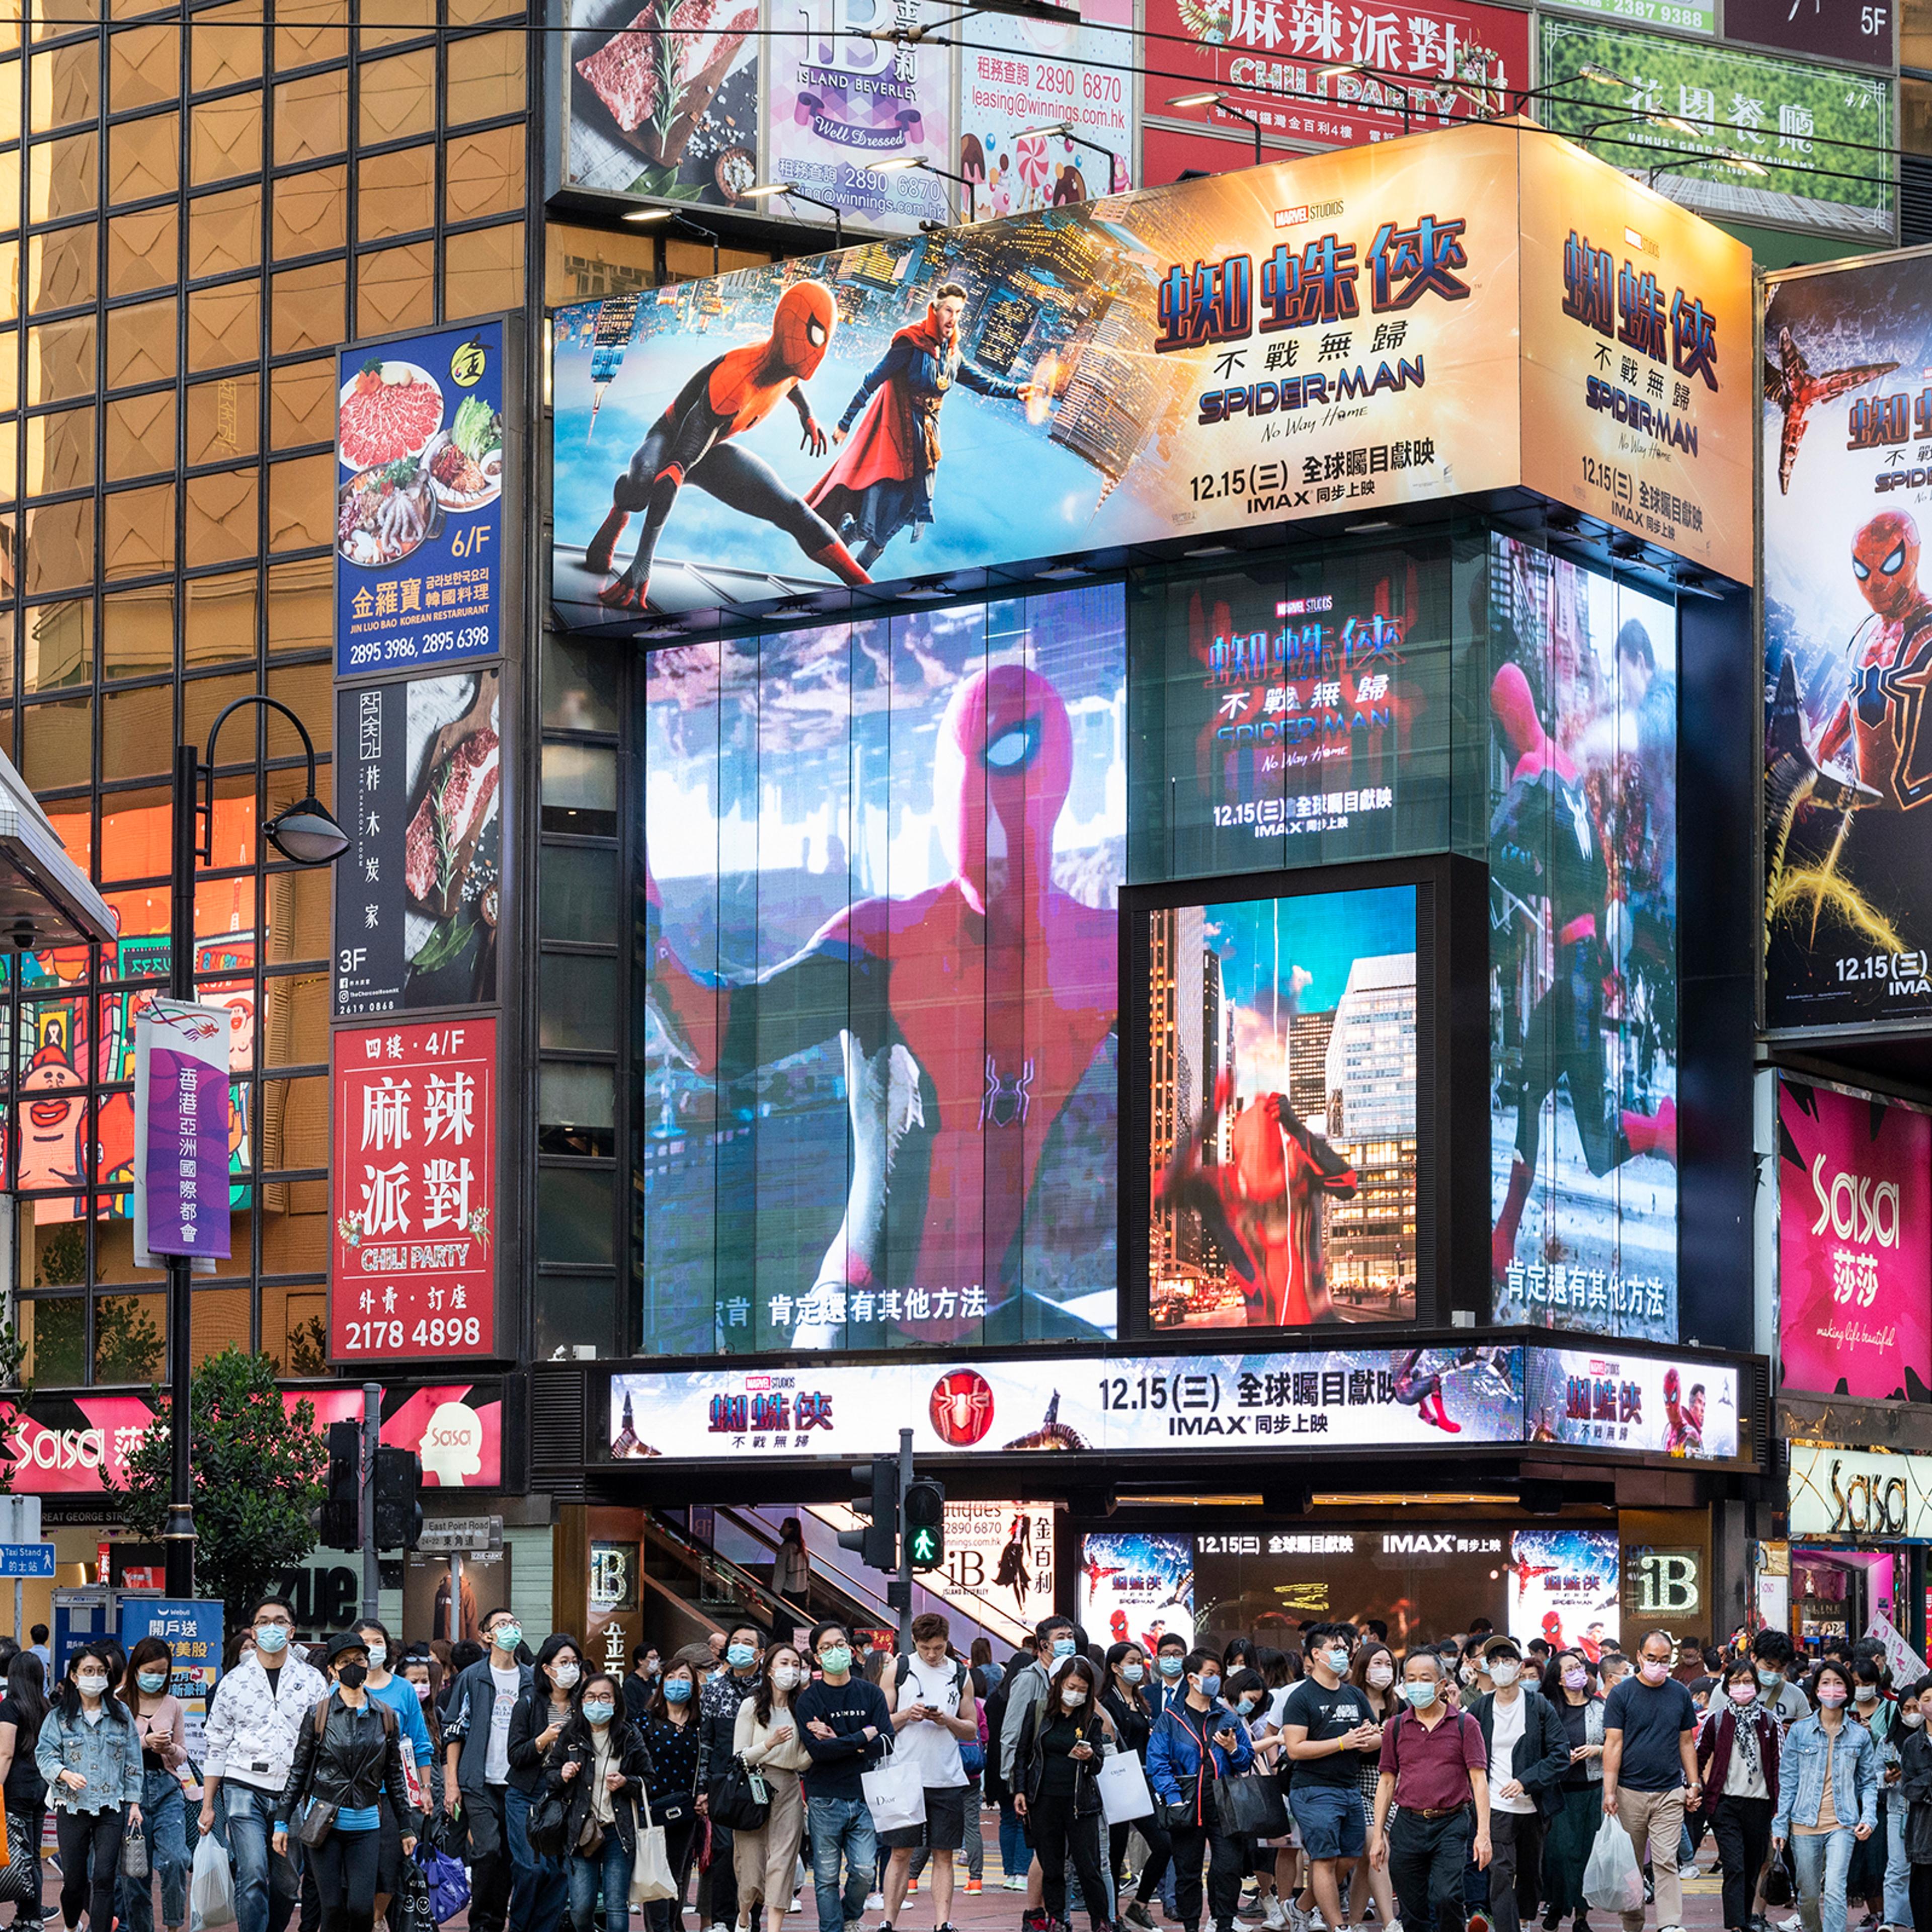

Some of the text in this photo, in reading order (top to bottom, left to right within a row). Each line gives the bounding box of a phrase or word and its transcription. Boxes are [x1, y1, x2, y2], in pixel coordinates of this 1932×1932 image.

[1614, 0, 1704, 28] 2387 9388
[1861, 6, 1887, 36] 5F
[1227, 0, 1462, 80] 麻辣派對
[797, 70, 920, 101] ISLAND BEVERLEY
[977, 55, 1121, 103] 租務查詢 2890 6870
[972, 86, 1125, 129] leasing@winnings.com.hk
[1337, 74, 1458, 124] PARTY
[1844, 92, 1872, 110] 4/F
[815, 115, 906, 147] Well Dressed
[778, 157, 941, 201] 租務查詢 2890 6870
[1276, 201, 1344, 227] MARVEL STUDIOS
[1155, 213, 1471, 354] 蜘蛛俠
[1562, 228, 1719, 392] 蜘蛛俠
[1213, 319, 1408, 380] 不戰無歸
[1593, 342, 1691, 413] 不戰無歸
[1261, 423, 1281, 443] No
[1284, 419, 1316, 440] Way
[1618, 432, 1629, 450] No
[1630, 437, 1647, 459] Way
[1190, 438, 1435, 502] 12.15(三) 全球矚目獻映
[1581, 455, 1633, 504] 12.15(三)
[1247, 479, 1376, 514] IMAX 同步上映
[1612, 501, 1675, 542] IMAX 同步上映
[451, 525, 491, 557] 6/F
[352, 577, 422, 619] 金羅寶
[425, 582, 490, 608] 韓國料理
[350, 624, 362, 634] JIN
[362, 620, 380, 631] LUO
[380, 617, 397, 629] BAO
[400, 612, 432, 626] KOREAN
[350, 624, 489, 665] 2895 3986, 2895 6398
[1204, 613, 1406, 688] 蜘蛛俠
[1220, 674, 1390, 719] 不戰無歸
[1261, 755, 1278, 772] No
[1213, 798, 1285, 828] 12.15(三)
[1255, 820, 1302, 837] IMAX
[364, 764, 380, 929] 柞木炭家
[339, 947, 367, 973] 3F
[1835, 949, 1928, 982] 12.15(三)
[340, 1000, 394, 1015] 2619 0868
[365, 1029, 464, 1059] 四樓 4/F
[360, 1071, 475, 1151] 麻辣
[179, 1067, 198, 1243] 香港亞洲國際都會
[360, 1158, 474, 1236] 派對
[1812, 1152, 1899, 1249] Sasa
[360, 1243, 470, 1272] CHILI PARTY
[1505, 1257, 1665, 1318] 肯定還有其他方法
[1833, 1248, 1878, 1308] 莎莎
[358, 1283, 468, 1315] 外賣 訂座
[768, 1286, 988, 1327] 肯定還有其他方法
[345, 1316, 480, 1350] 2178 4898
[1816, 1319, 1895, 1355] making life beautiful
[746, 1376, 795, 1391] MARVEL STUDIOS
[1099, 1373, 1221, 1410] 12.15(三)
[1566, 1375, 1643, 1425] 蜘蛛俠
[707, 1391, 834, 1433] 蜘蛛俠
[1169, 1414, 1328, 1436] IMAX 同步上映
[16, 1422, 104, 1470] Sasa
[431, 1426, 472, 1447] Sasa
[732, 1435, 810, 1450] 不戰無歸
[944, 1503, 1001, 1522] utiques
[1830, 1459, 1908, 1536] Sasa
[41, 1511, 104, 1522] REAT GEORGE
[429, 1520, 489, 1531] East Point Road
[945, 1522, 1002, 1534] 2890 6870
[6, 1548, 41, 1557] Taxi Stand
[443, 1535, 474, 1546] 東角道
[944, 1537, 1002, 1549] innings.com.hk
[1033, 1516, 1053, 1594] 金百利
[1197, 1536, 1260, 1554] 12.15(三)
[1383, 1535, 1501, 1553] IMAX 同步上映
[9, 1561, 38, 1572] 的士站
[948, 1551, 985, 1587] iB
[1639, 1555, 1699, 1611] iB
[149, 1619, 198, 1638] 開戶送
[876, 1795, 896, 1806] Dior
